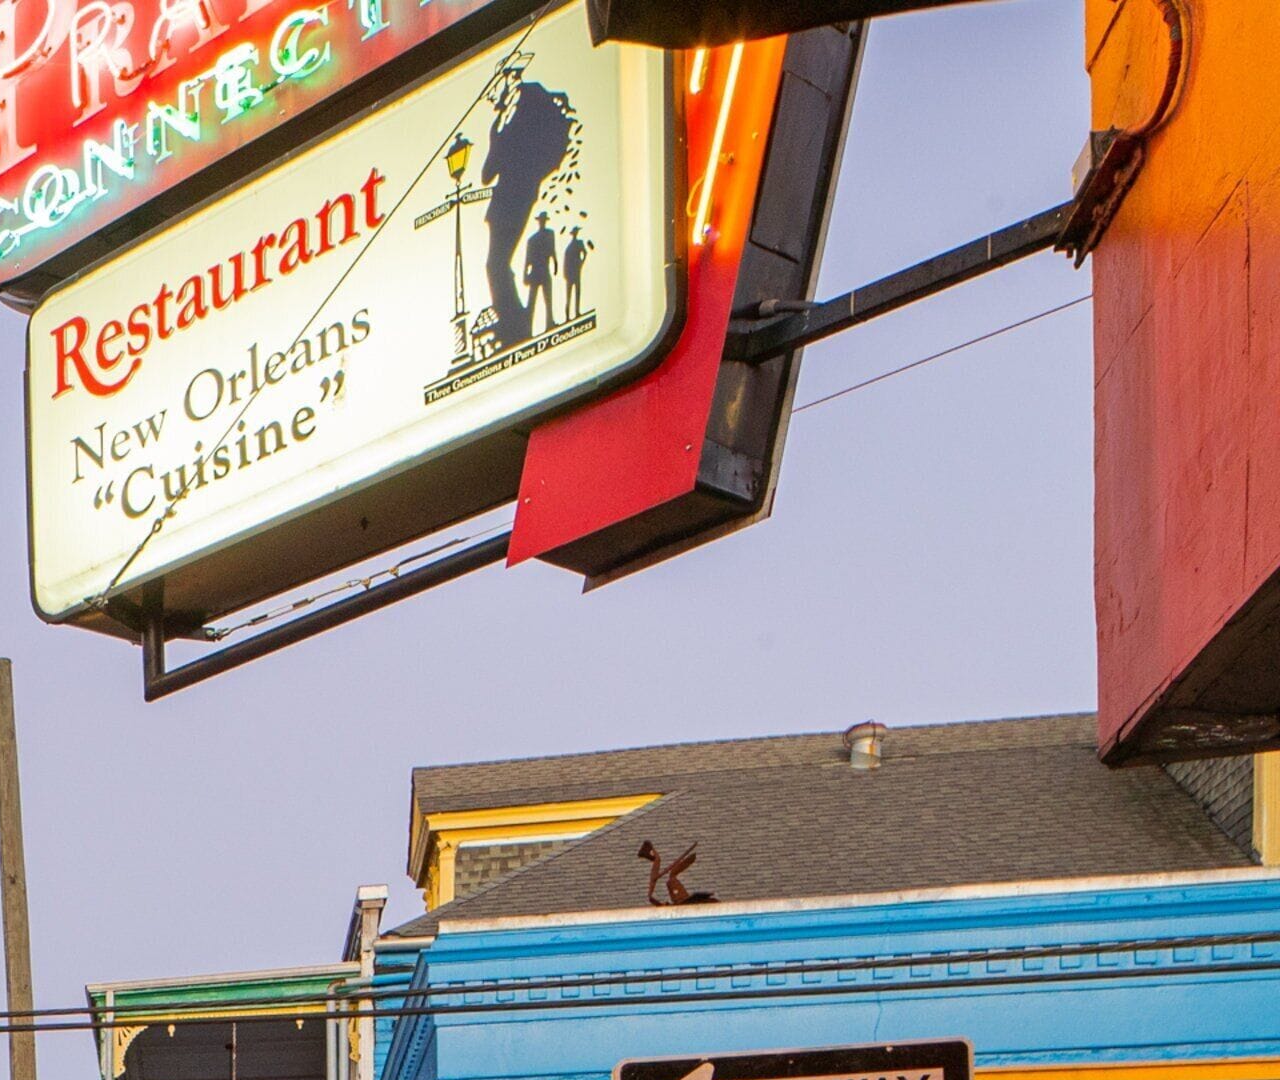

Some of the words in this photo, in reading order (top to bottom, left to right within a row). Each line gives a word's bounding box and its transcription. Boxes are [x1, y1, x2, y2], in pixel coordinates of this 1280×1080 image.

[415, 202, 450, 229] FRENCHMEN
[50, 167, 386, 400] Restaurant
[70, 409, 168, 484] New
[183, 308, 371, 422] Orleans
[426, 387, 452, 403] Three
[452, 363, 503, 390] Generations
[503, 354, 514, 368] of
[514, 346, 536, 363] Pure
[551, 320, 593, 346] Goodness
